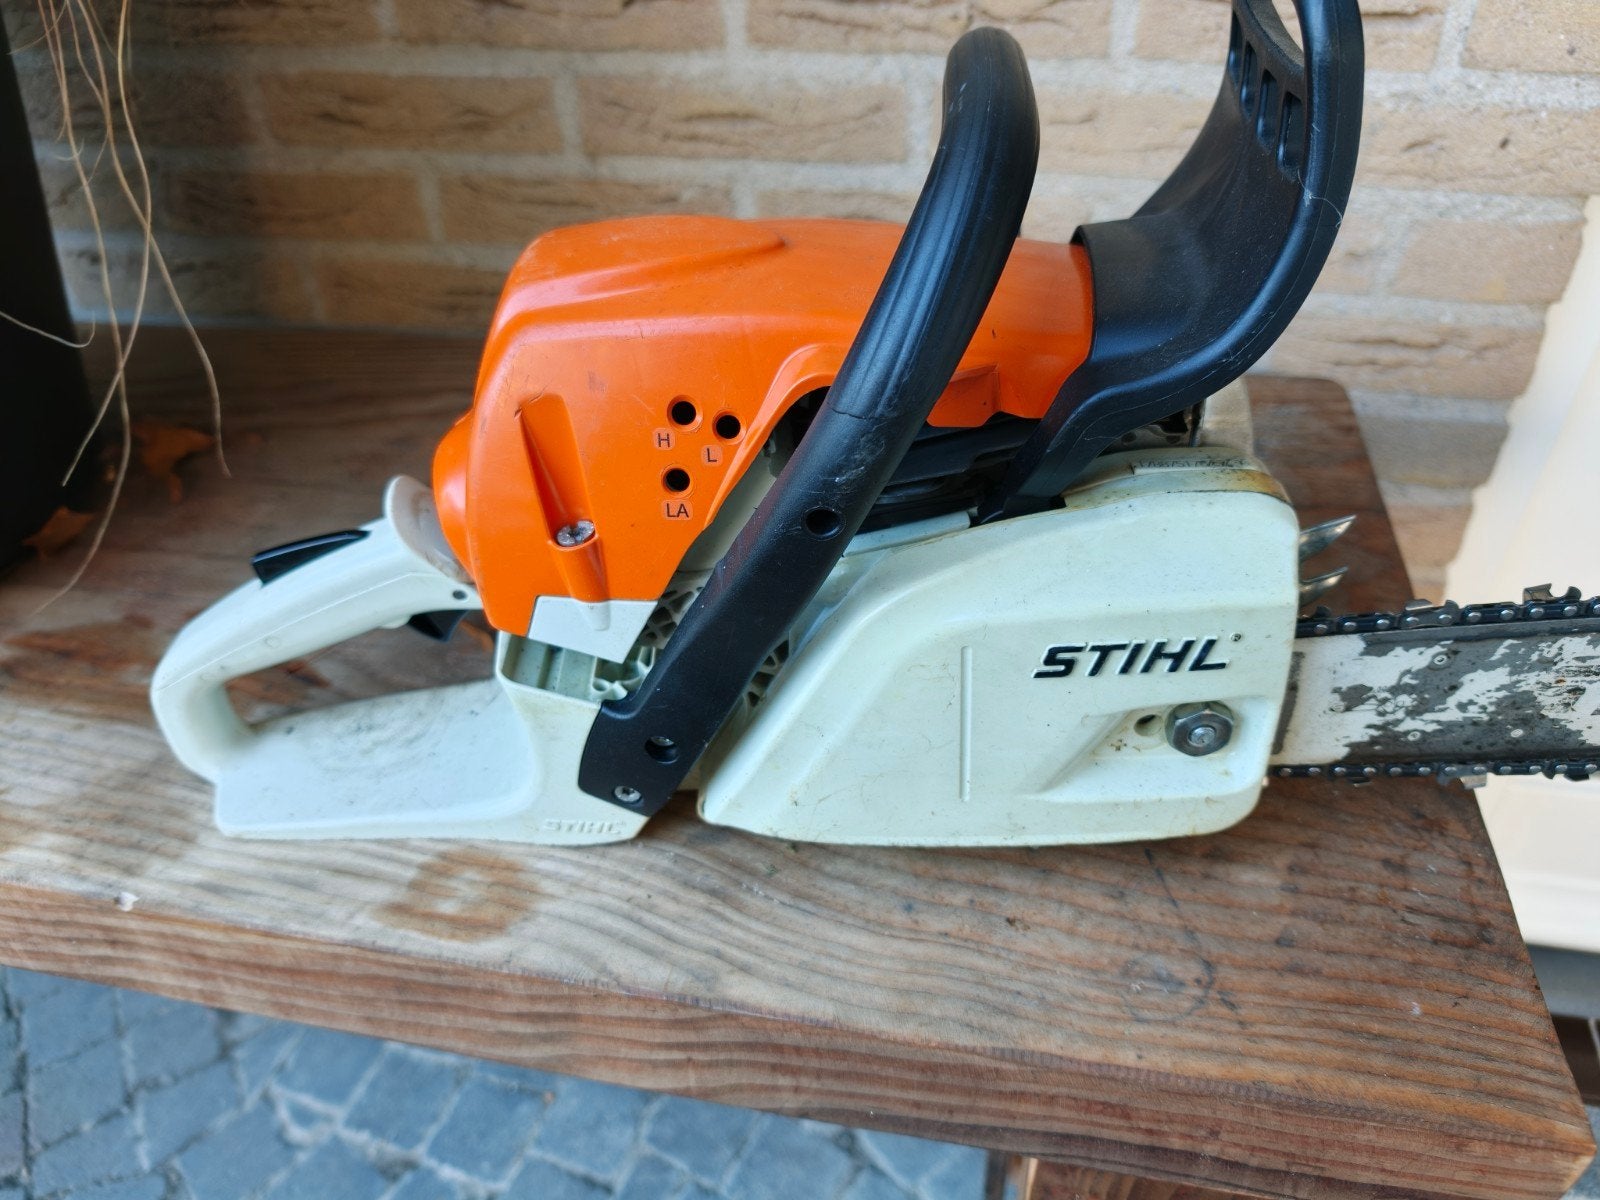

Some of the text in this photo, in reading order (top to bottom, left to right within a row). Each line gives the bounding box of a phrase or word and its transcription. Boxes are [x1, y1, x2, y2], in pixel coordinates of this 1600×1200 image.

[657, 432, 671, 448] H
[706, 447, 718, 463] L
[666, 502, 690, 518] LA
[1032, 636, 1231, 679] STIHL
